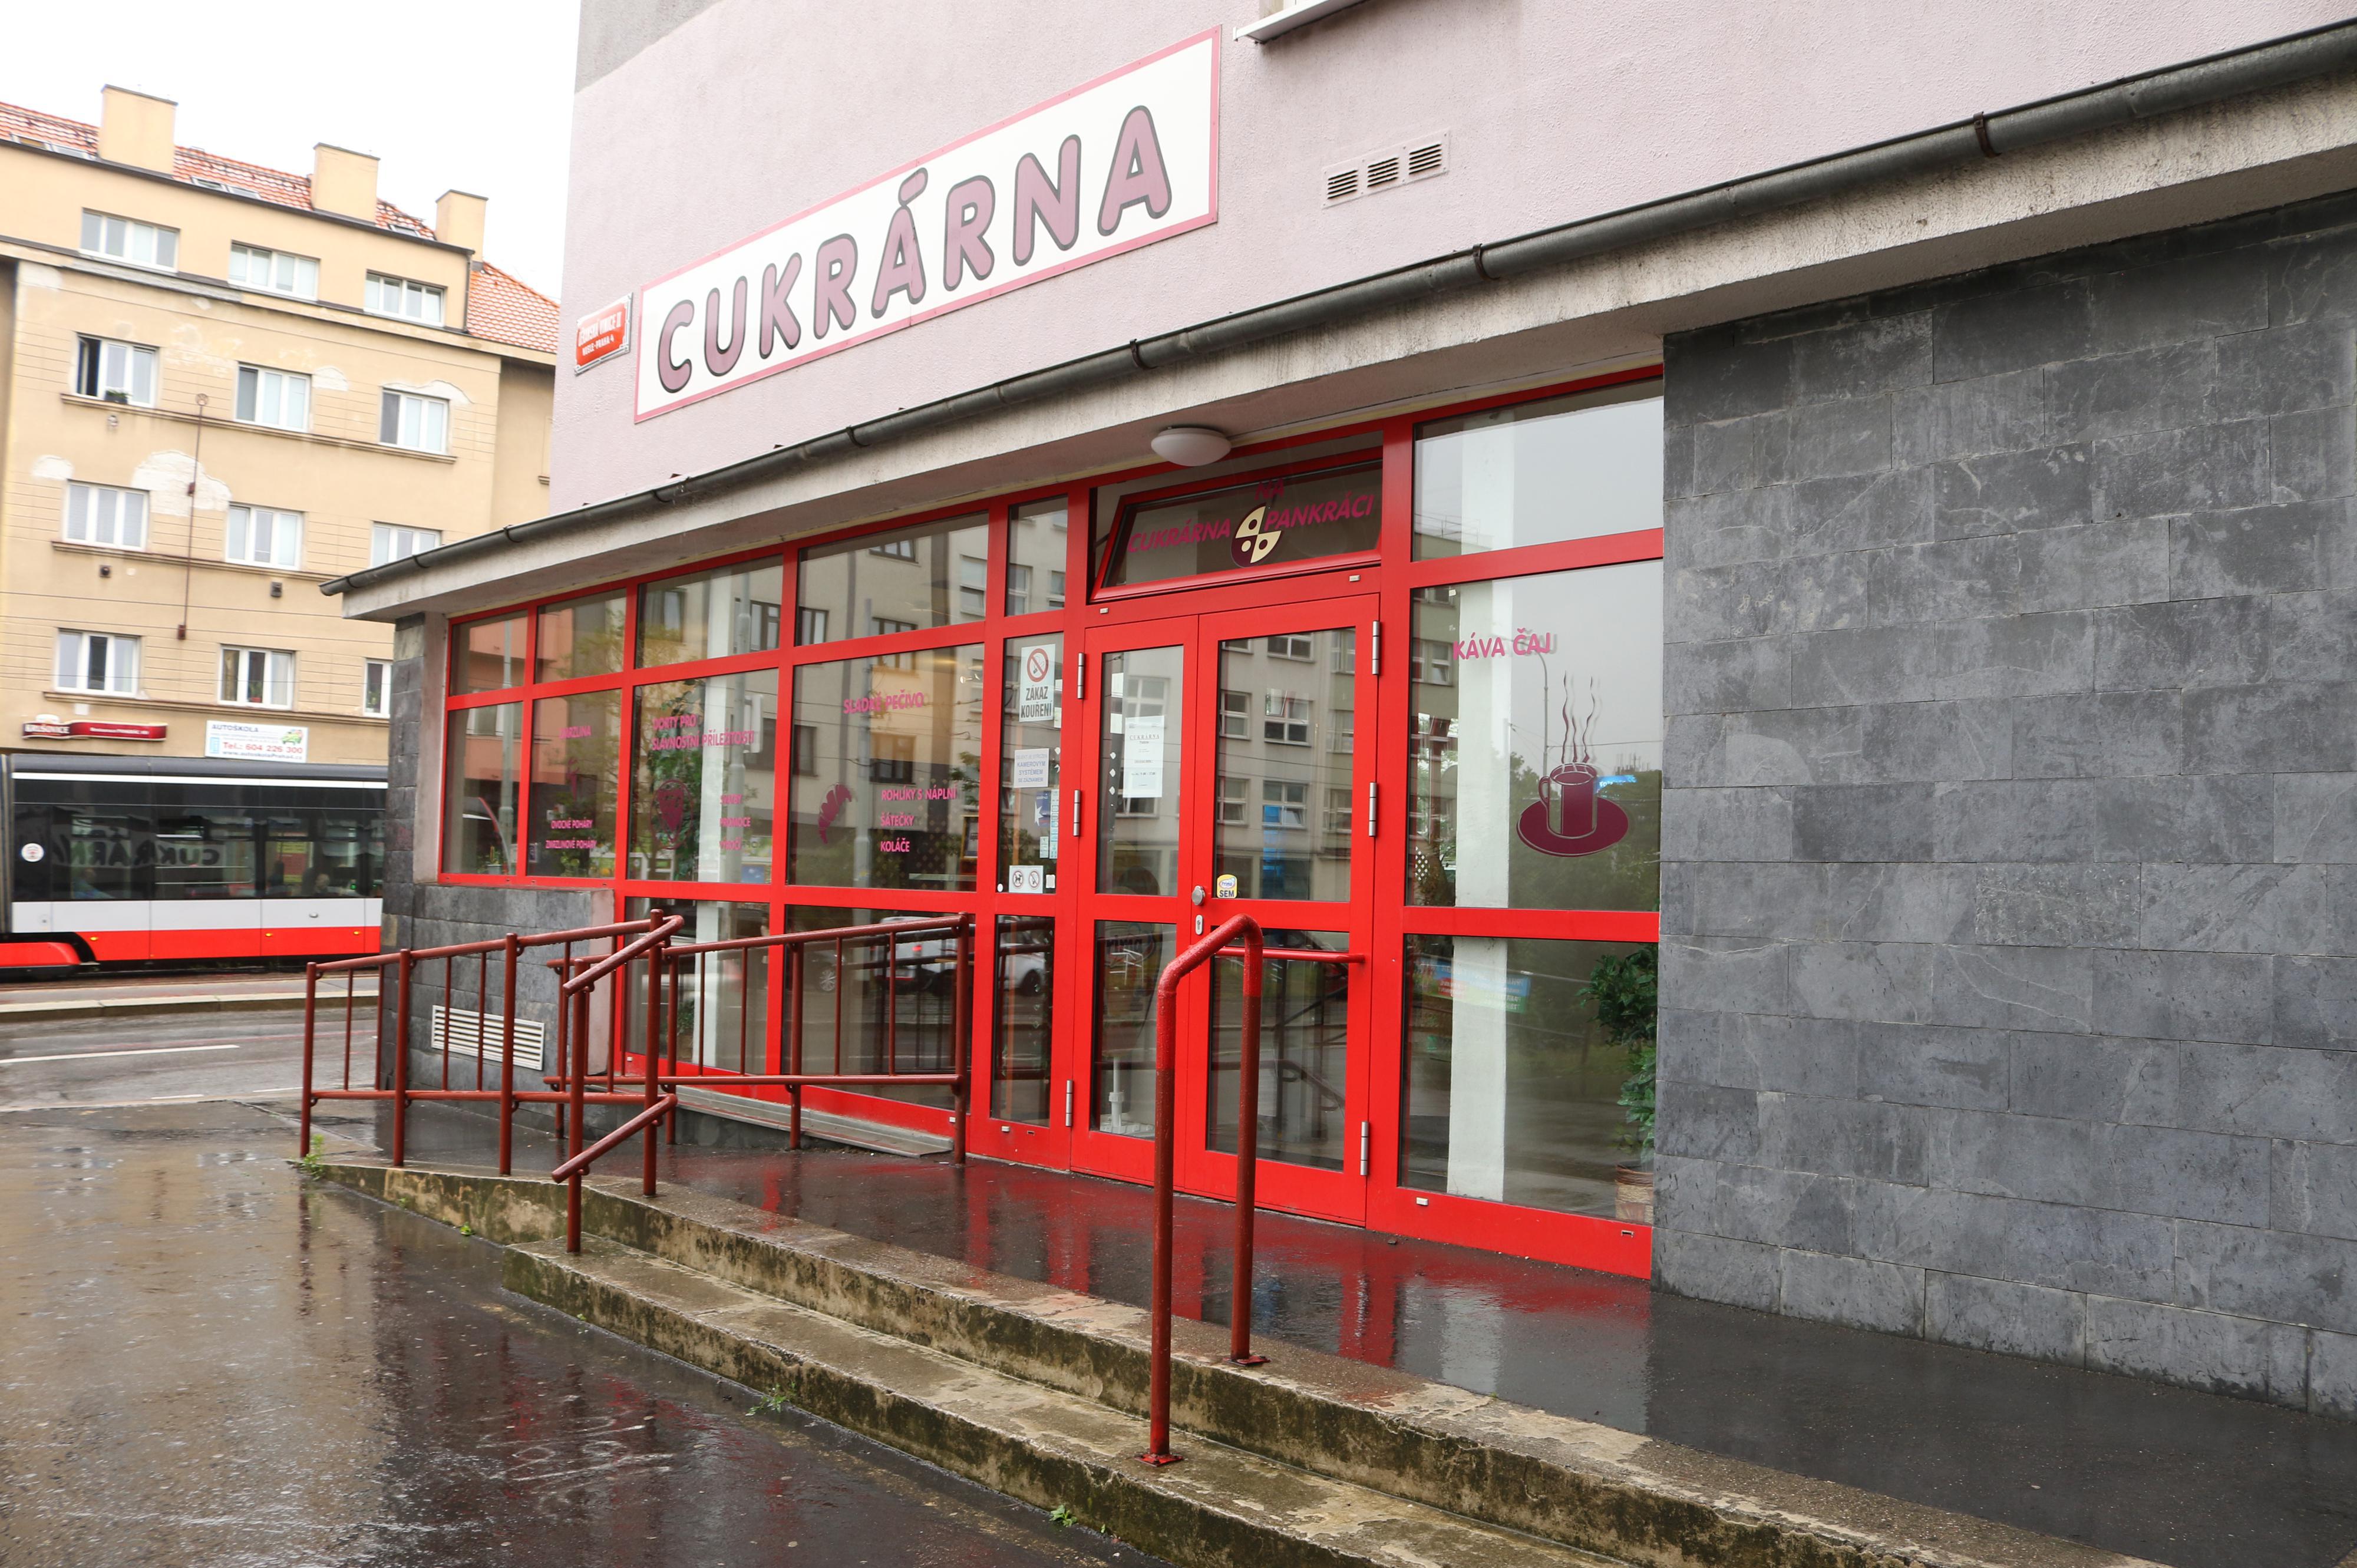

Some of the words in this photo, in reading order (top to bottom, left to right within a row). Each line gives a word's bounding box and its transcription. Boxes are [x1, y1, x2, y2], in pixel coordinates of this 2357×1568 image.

[657, 105, 1171, 393] CUKRÁRNA
[1255, 478, 1285, 500] NA
[1127, 519, 1231, 553] CUKRÁRNA
[1264, 491, 1375, 531] PANKRÁCI
[1453, 632, 1505, 660] KÁVA
[1513, 628, 1551, 655] ČAJ
[885, 689, 924, 710] PEČIVO
[1026, 685, 1048, 701] ZÁKAZ
[1021, 700, 1052, 718] KOUŘENÍ
[212, 724, 259, 732] AUTOŠKOLA
[653, 715, 678, 730] DORTY
[680, 714, 697, 727] PRO
[652, 729, 699, 751] SLAVNOSTNÍ
[882, 785, 915, 800] ROHLÍKY
[917, 789, 923, 800] S
[925, 783, 958, 800] NÁPLNÍ
[880, 811, 915, 827] ŠÁTEČKY
[880, 837, 910, 852] KOLÁČE
